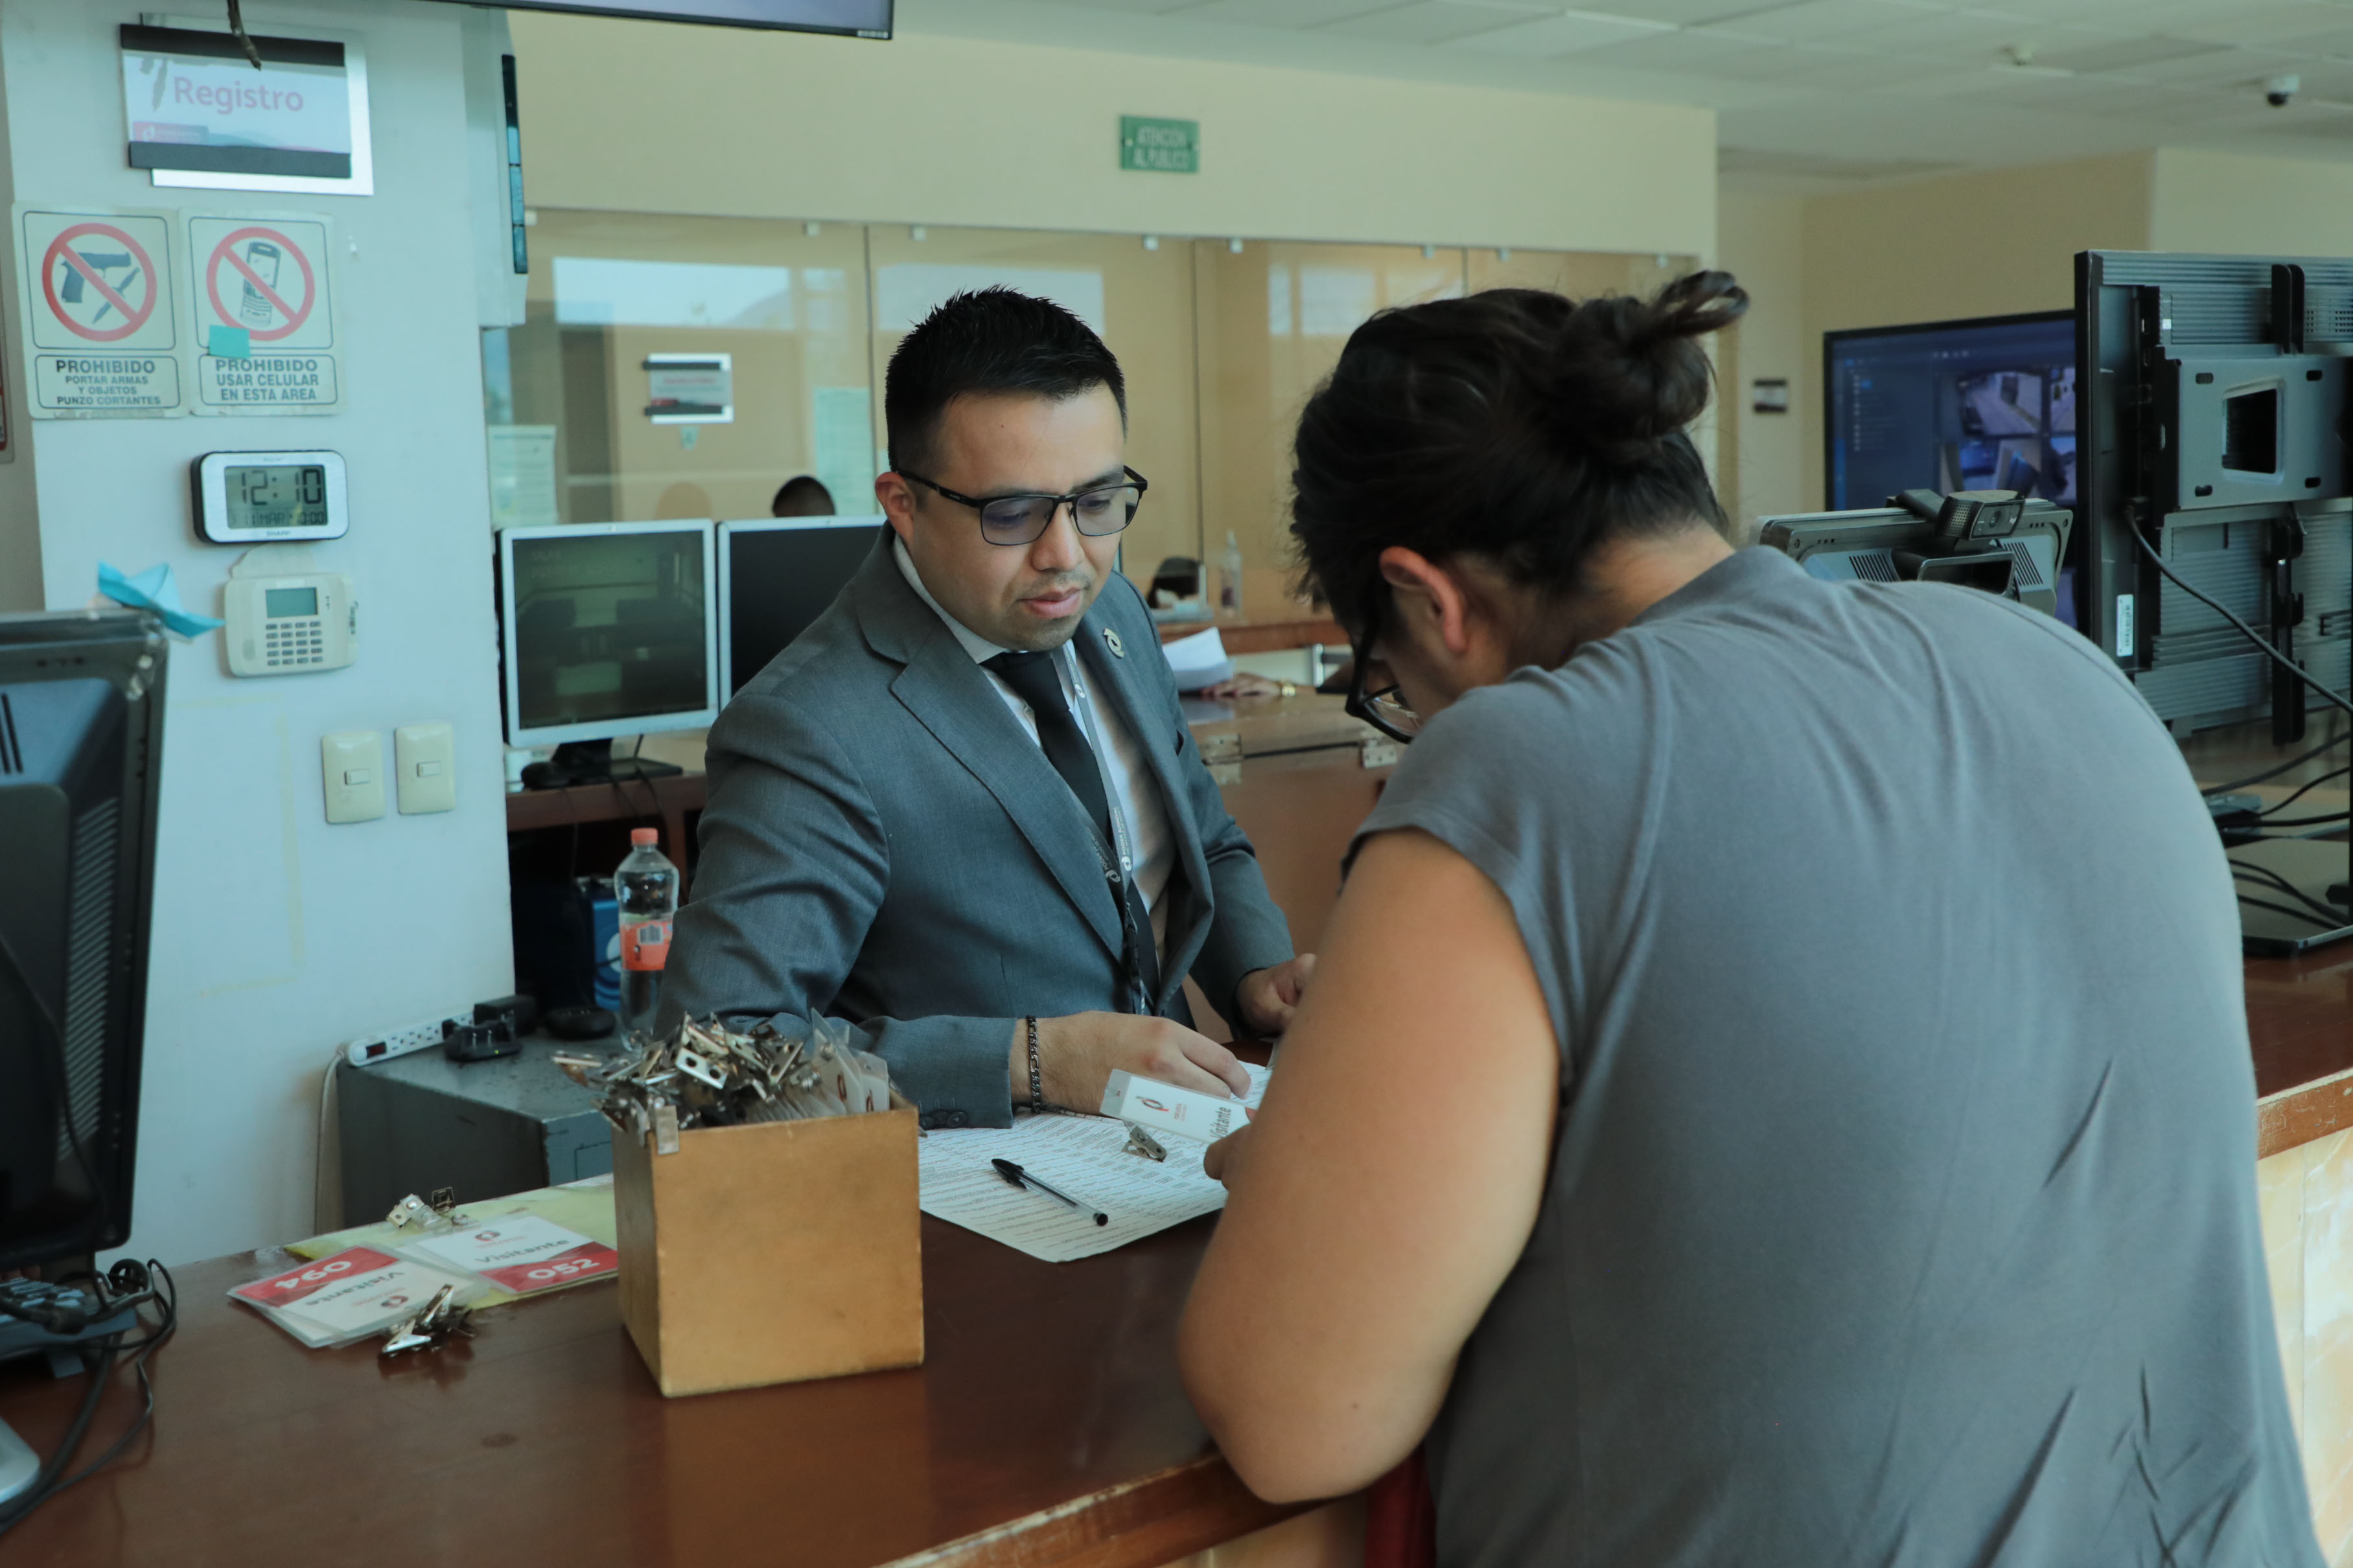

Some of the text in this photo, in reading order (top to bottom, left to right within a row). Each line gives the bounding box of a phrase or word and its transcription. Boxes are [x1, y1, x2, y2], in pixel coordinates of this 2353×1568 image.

[173, 75, 304, 115] Registro
[56, 360, 156, 374] PROHIBIDO
[215, 359, 318, 372] PROHIBIDO
[65, 375, 148, 384] PORTAR ARMAS
[216, 374, 319, 386] USAR CELULAR
[88, 386, 137, 395] OBJETOS
[221, 388, 317, 400] EN ESTA AREA
[57, 396, 161, 405] PUNZO CORTANTES
[242, 468, 322, 505] 12:10
[1209, 1107, 1233, 1139] Visitante
[474, 1238, 570, 1263] Visitante
[274, 1260, 352, 1290] 094
[527, 1258, 601, 1280] 052
[305, 1271, 406, 1306] Visitante
